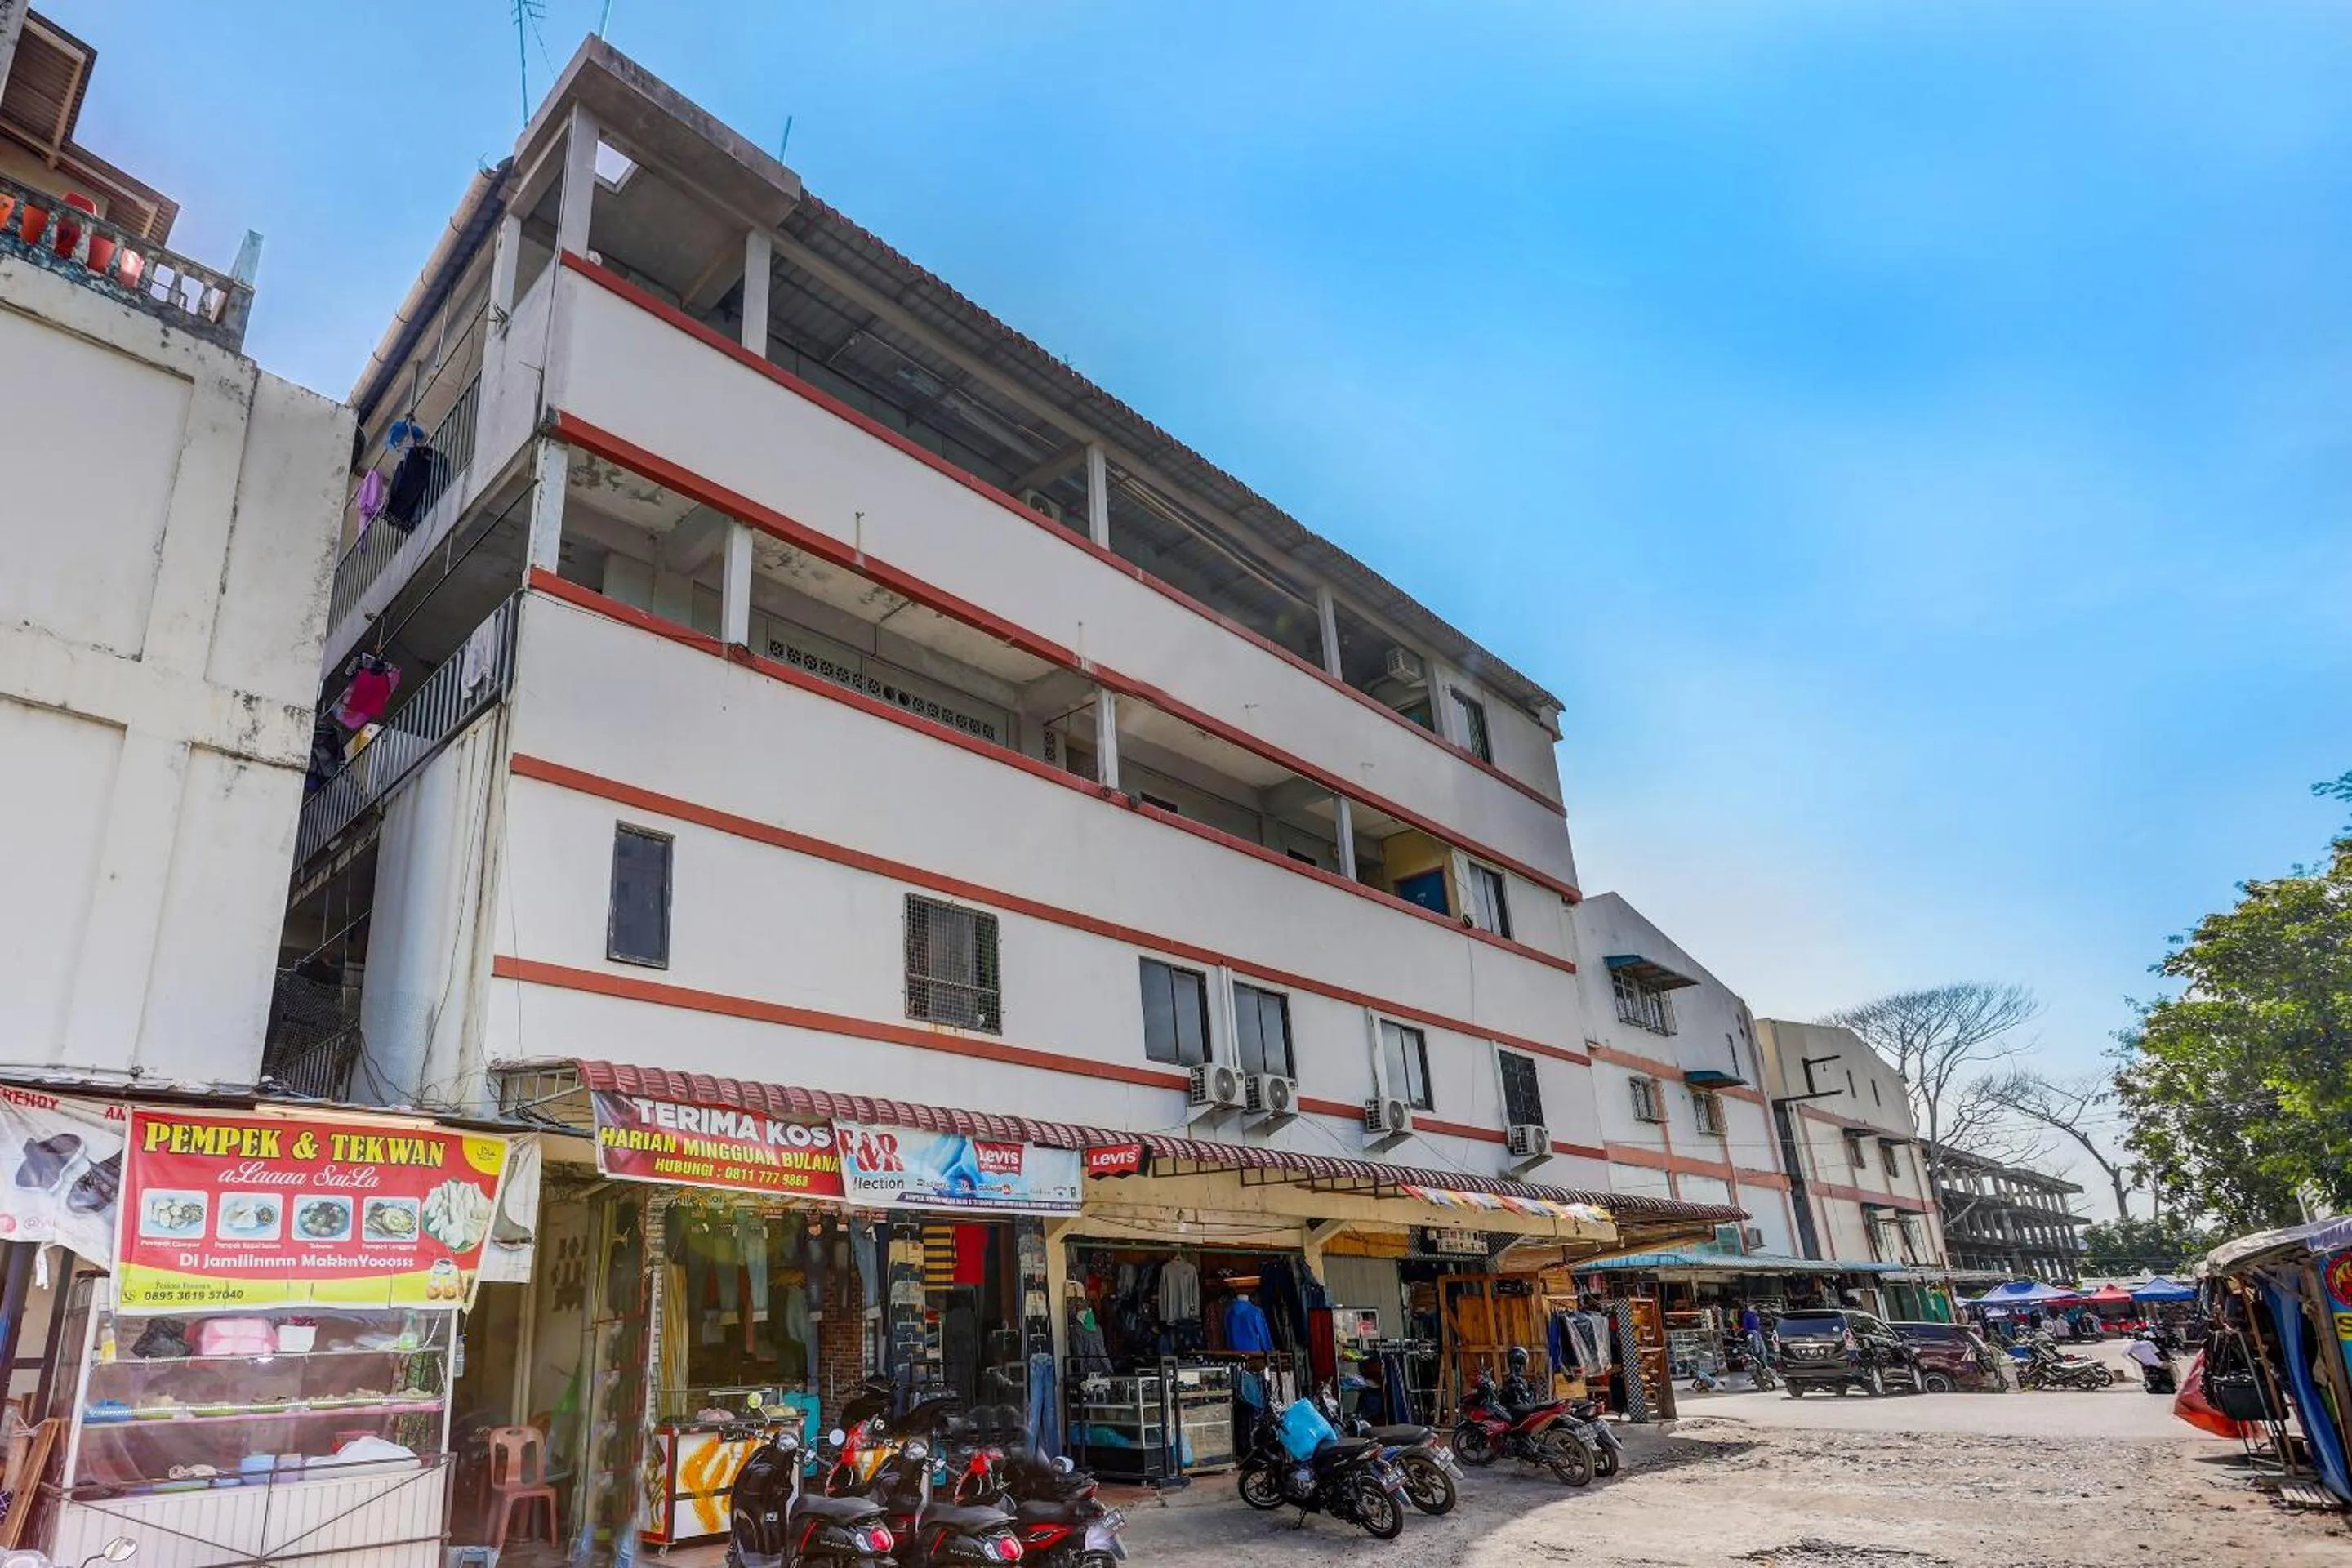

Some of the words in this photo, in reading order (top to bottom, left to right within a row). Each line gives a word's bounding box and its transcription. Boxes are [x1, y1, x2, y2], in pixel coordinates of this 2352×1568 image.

[0, 1088, 59, 1109] RENDY
[631, 1097, 760, 1143] TERIMA
[765, 1119, 832, 1148] KOS
[143, 1121, 282, 1158] PEMPEK
[292, 1131, 320, 1160] &
[330, 1133, 446, 1167] TEKWAN
[600, 1127, 676, 1153] HARIAN
[683, 1138, 778, 1167] MINGGUAN
[781, 1152, 841, 1174] BULANA
[655, 1158, 714, 1177] HUBUNGI
[724, 1165, 754, 1182] 0811
[759, 1170, 780, 1184] 777
[180, 1253, 199, 1267] Di
